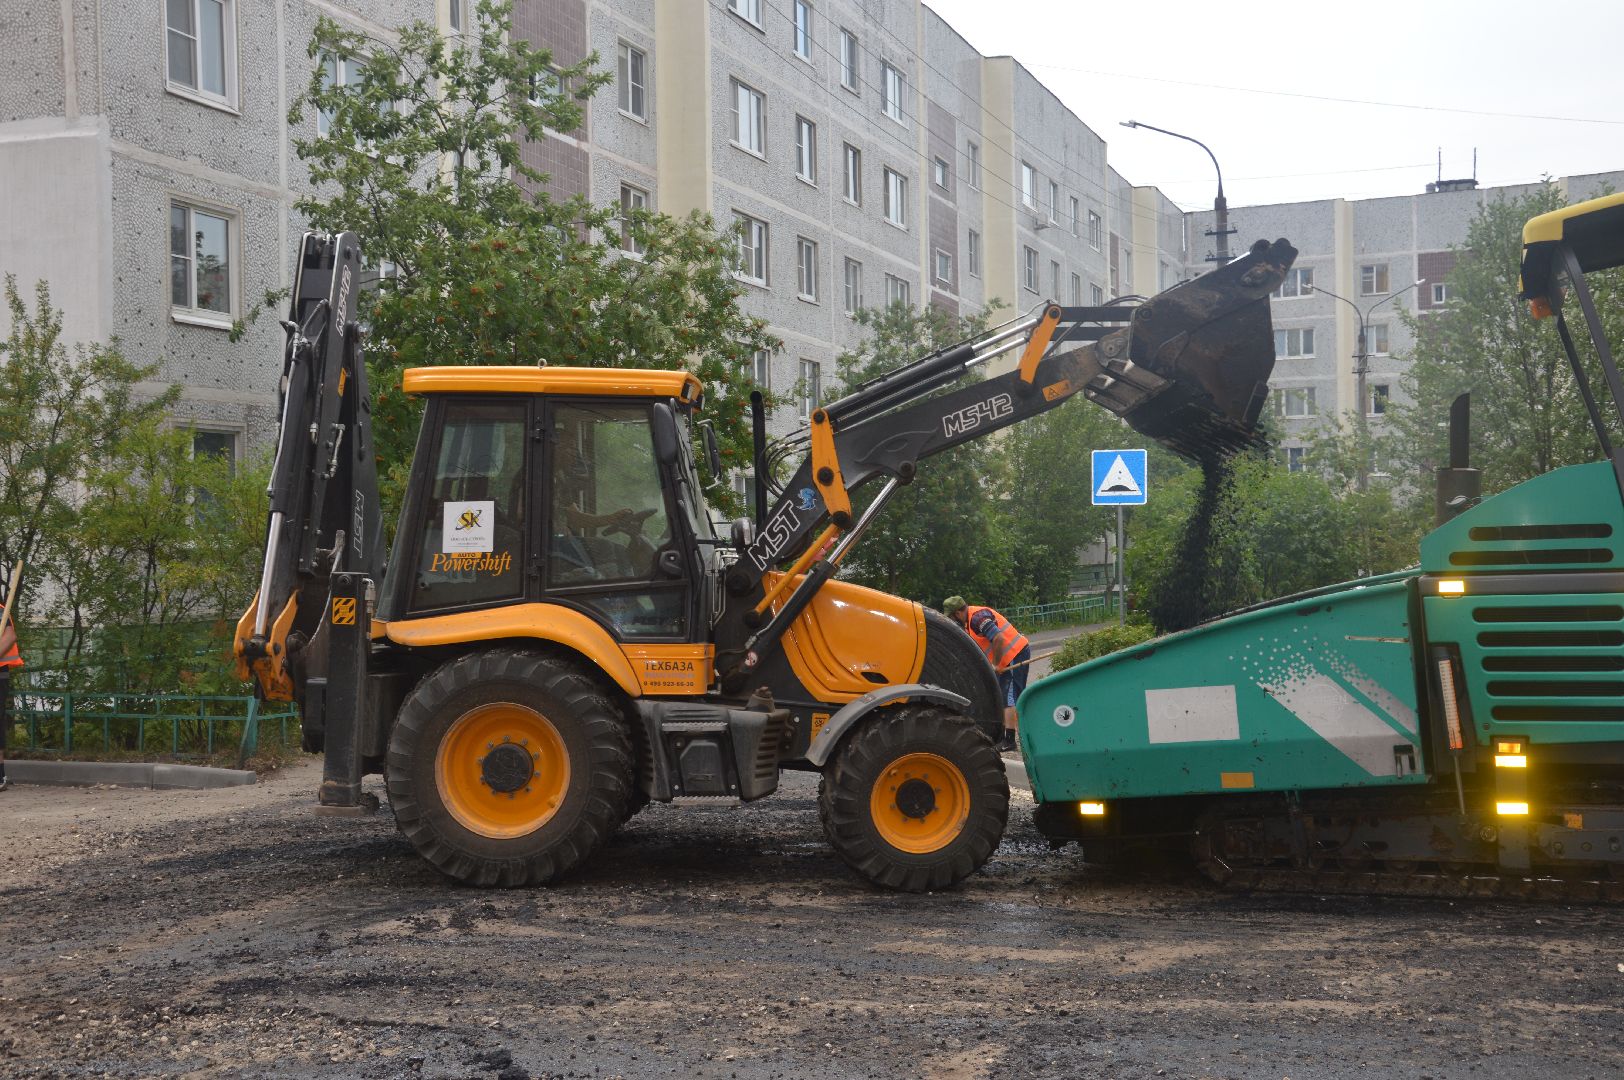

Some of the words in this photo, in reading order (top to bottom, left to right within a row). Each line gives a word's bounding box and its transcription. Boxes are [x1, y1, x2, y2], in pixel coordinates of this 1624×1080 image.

[942, 392, 1014, 438] M542
[353, 489, 364, 558] MST
[747, 499, 801, 571] MST
[428, 551, 512, 577] Powershift
[644, 661, 694, 671] ТЕХБАЗА
